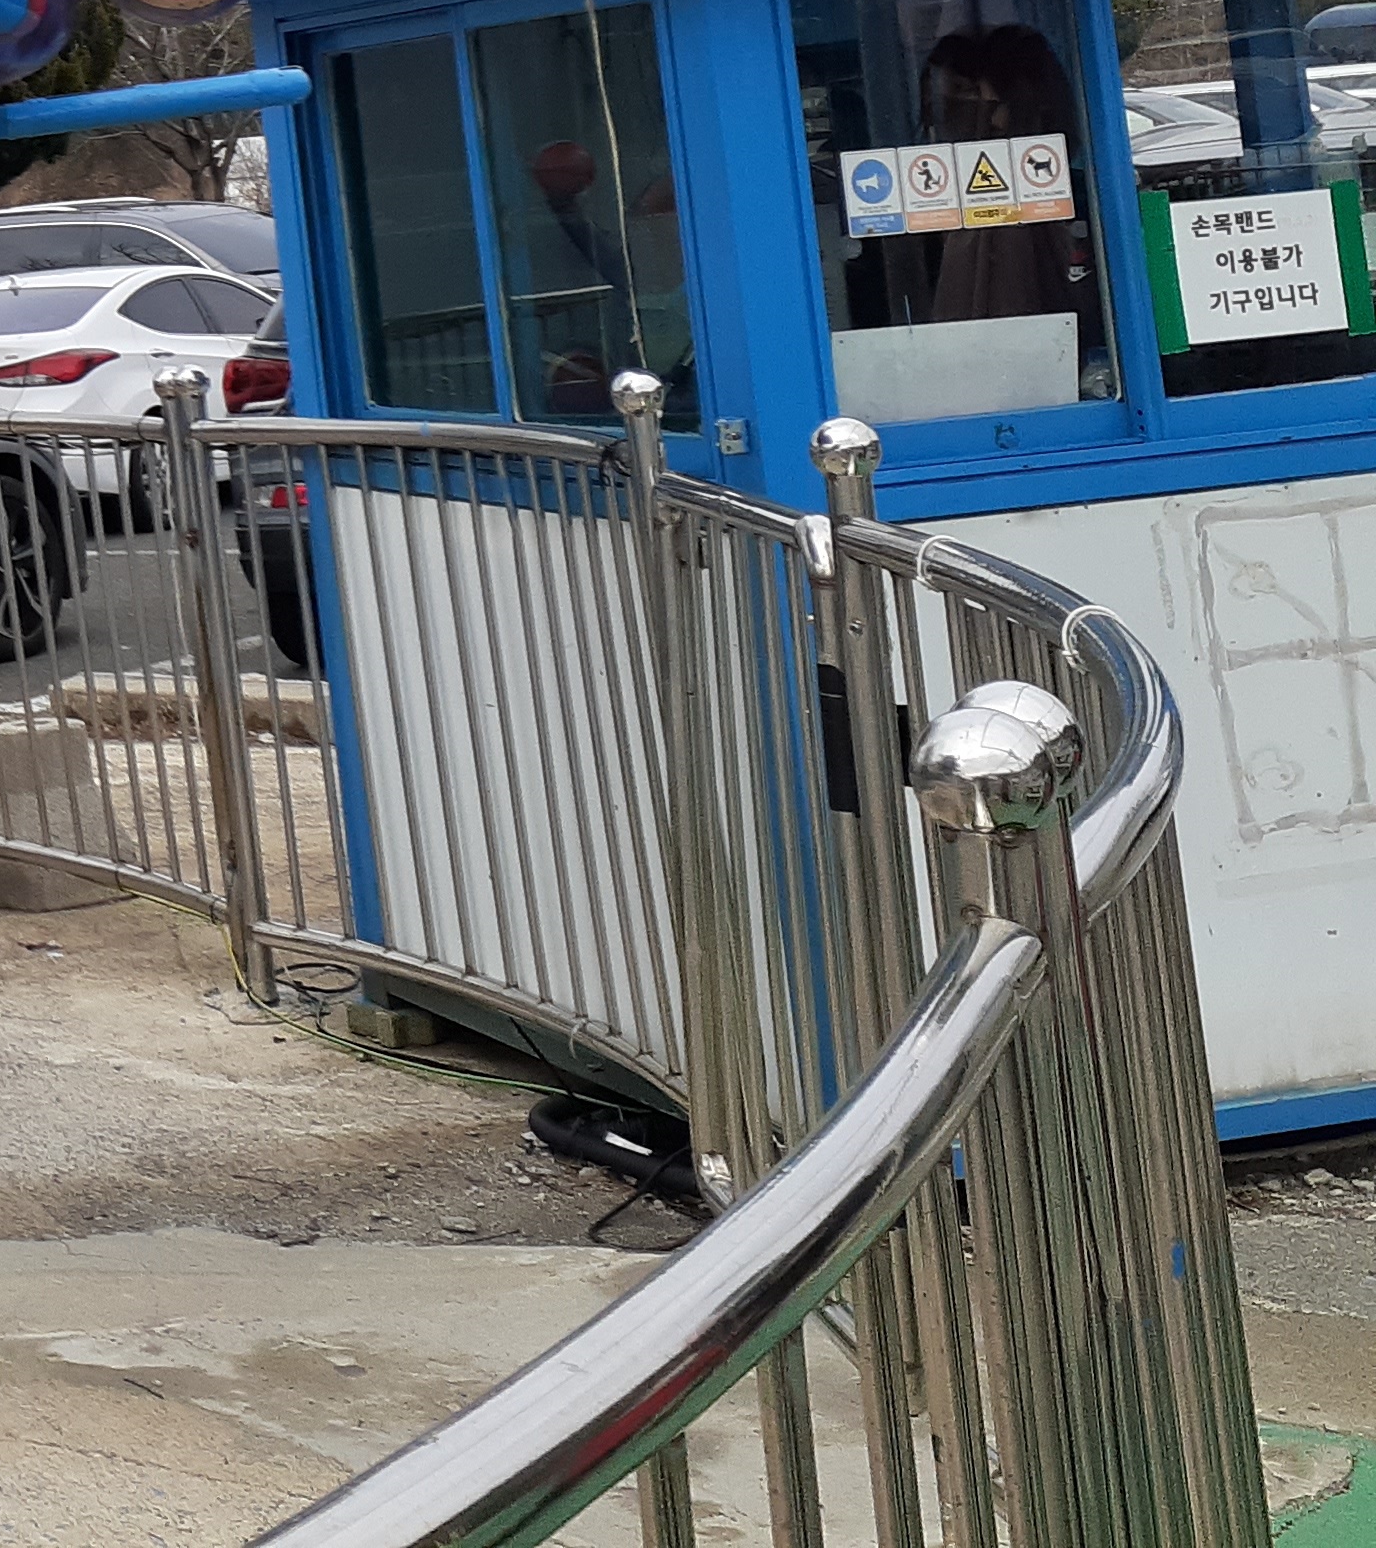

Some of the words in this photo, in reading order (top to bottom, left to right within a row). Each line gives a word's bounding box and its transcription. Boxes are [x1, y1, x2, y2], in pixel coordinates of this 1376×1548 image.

[1191, 210, 1276, 238] 손목밴드
[1215, 243, 1304, 274] 이용불가
[1209, 282, 1319, 314] 기구입니다
